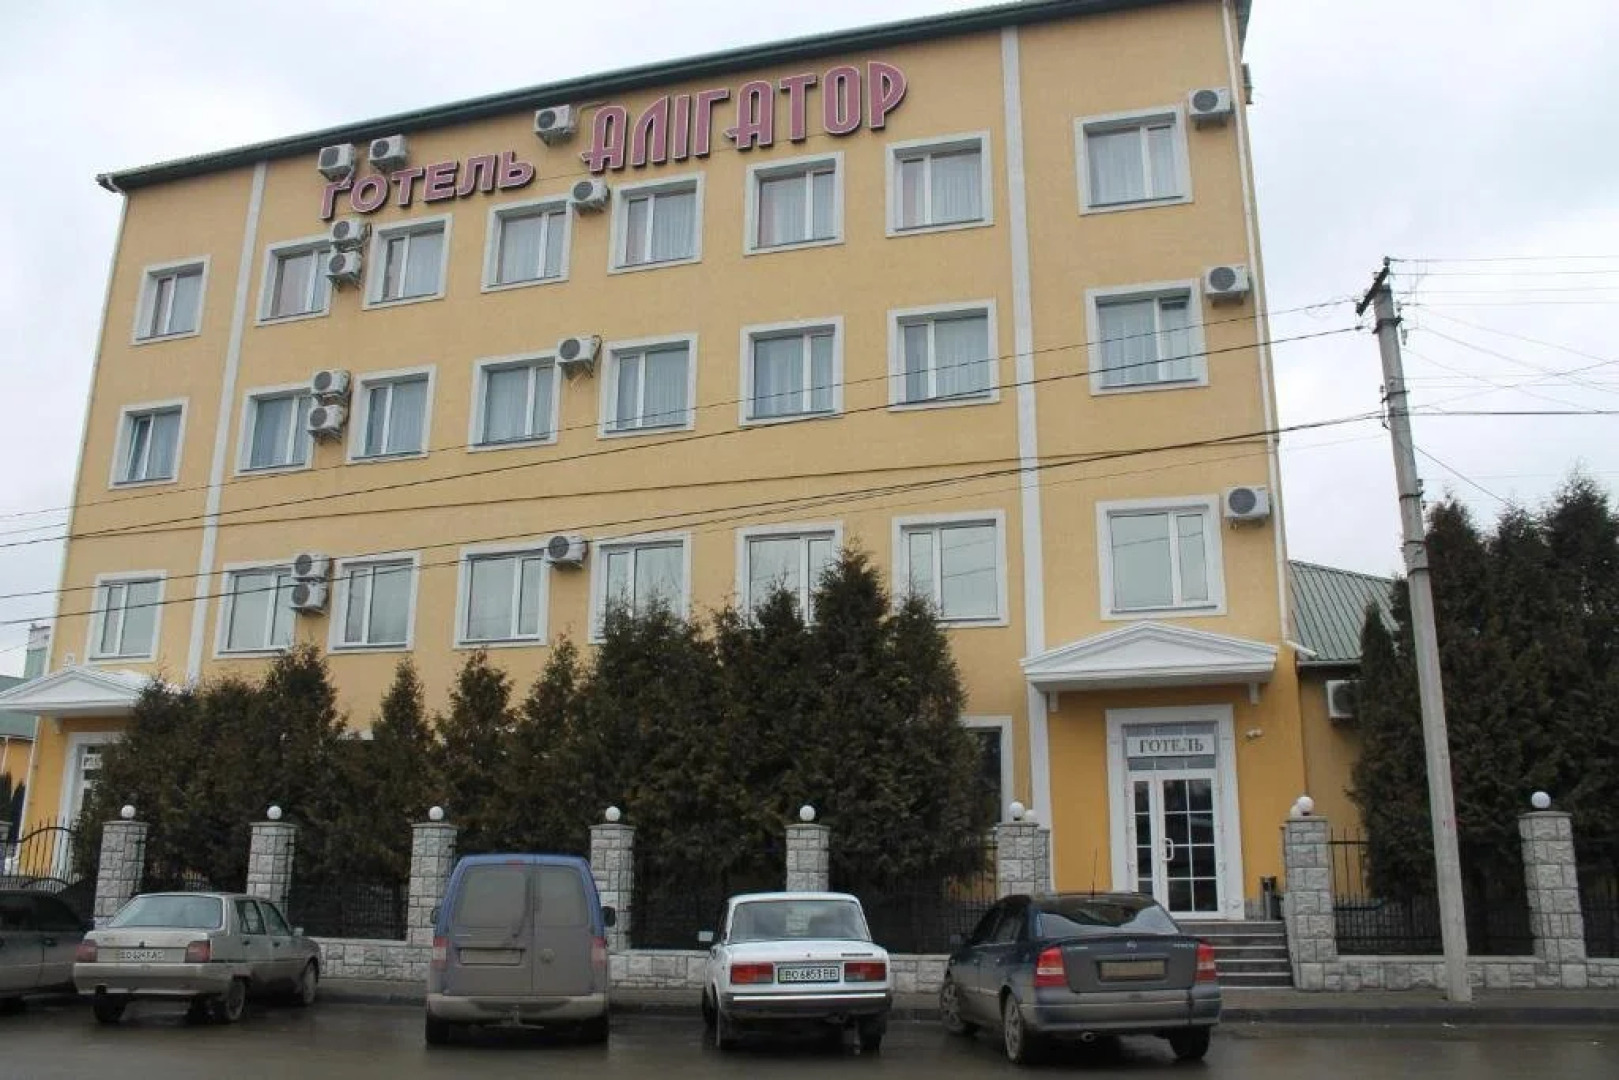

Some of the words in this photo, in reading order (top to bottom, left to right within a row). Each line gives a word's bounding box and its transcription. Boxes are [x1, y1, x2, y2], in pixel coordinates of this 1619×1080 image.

[320, 151, 535, 220] ГОТЕЛЬ
[580, 61, 908, 173] АЛІГАТОР
[1140, 737, 1204, 753] ГОТЕЛЬ
